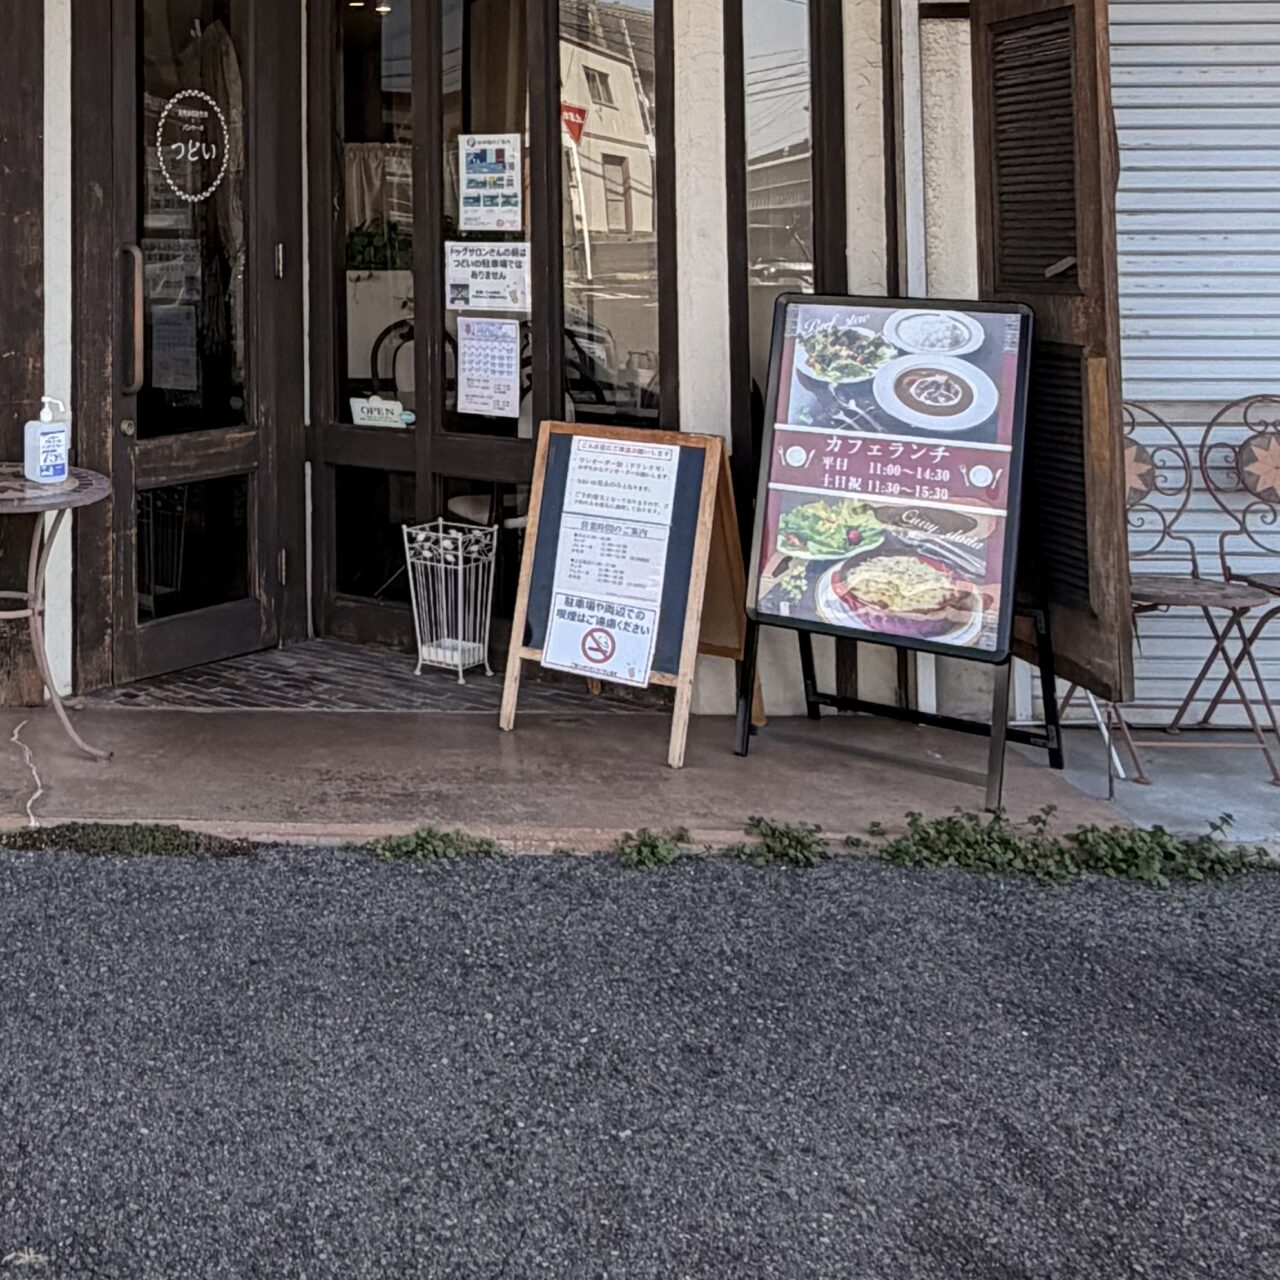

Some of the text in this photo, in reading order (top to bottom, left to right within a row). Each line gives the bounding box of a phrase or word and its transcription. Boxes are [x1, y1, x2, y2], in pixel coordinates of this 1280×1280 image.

[170, 139, 217, 161] つどい
[360, 406, 395, 416] OPEN
[825, 435, 951, 464] カフェランチ
[822, 456, 849, 471] 平日
[823, 473, 862, 491] 土日祝
[564, 596, 646, 621] 駐車場や周辺での
[556, 608, 651, 635] 喫煙はご遠慮ください
